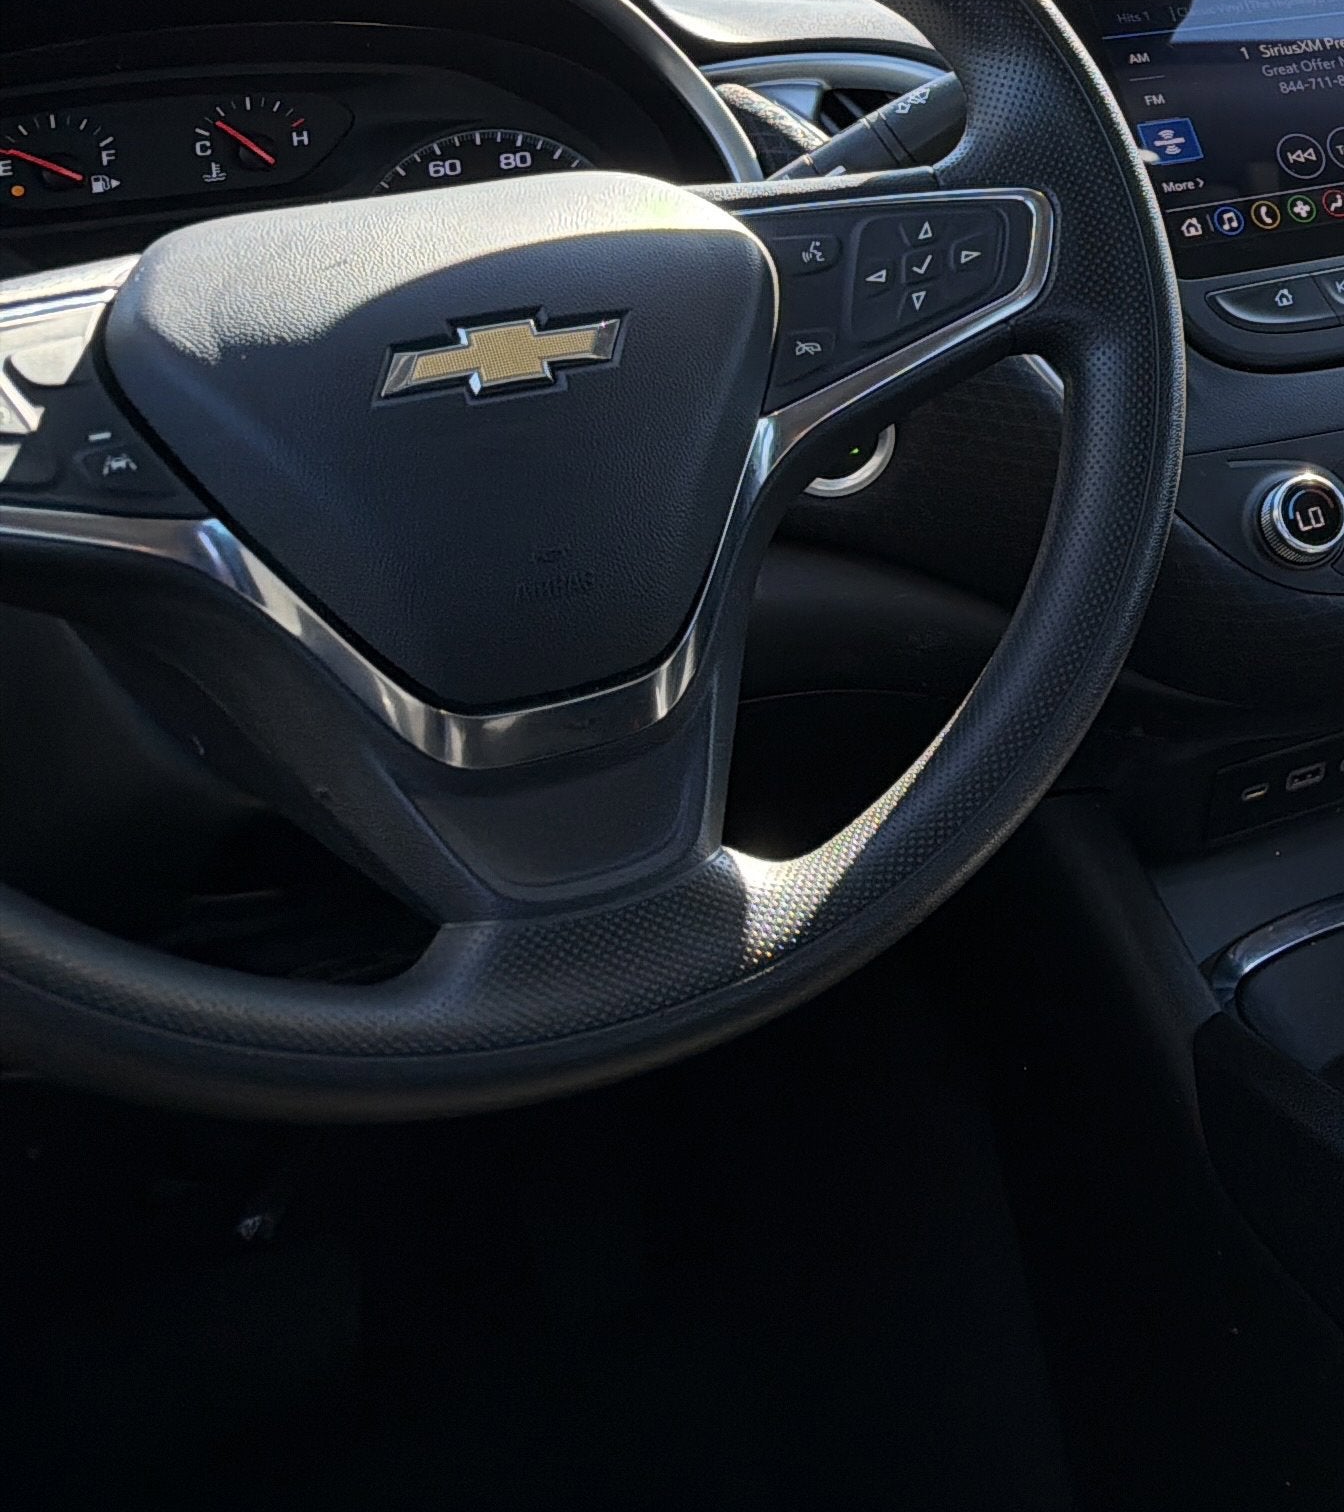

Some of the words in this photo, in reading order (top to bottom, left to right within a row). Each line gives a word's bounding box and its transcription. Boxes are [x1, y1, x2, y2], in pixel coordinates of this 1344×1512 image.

[1239, 46, 1250, 60] 1
[1258, 38, 1322, 58] SiriusXM
[1128, 52, 1151, 64] AM
[1261, 62, 1299, 78] Great
[1299, 57, 1338, 74] Offer
[1143, 93, 1166, 106] FM
[291, 130, 309, 146] H
[194, 140, 212, 156] C
[101, 149, 116, 166] F
[499, 151, 532, 170] 80
[0, 159, 13, 177] E
[428, 158, 462, 178] 60
[1161, 179, 1195, 193] More
[1295, 506, 1326, 531] LO
